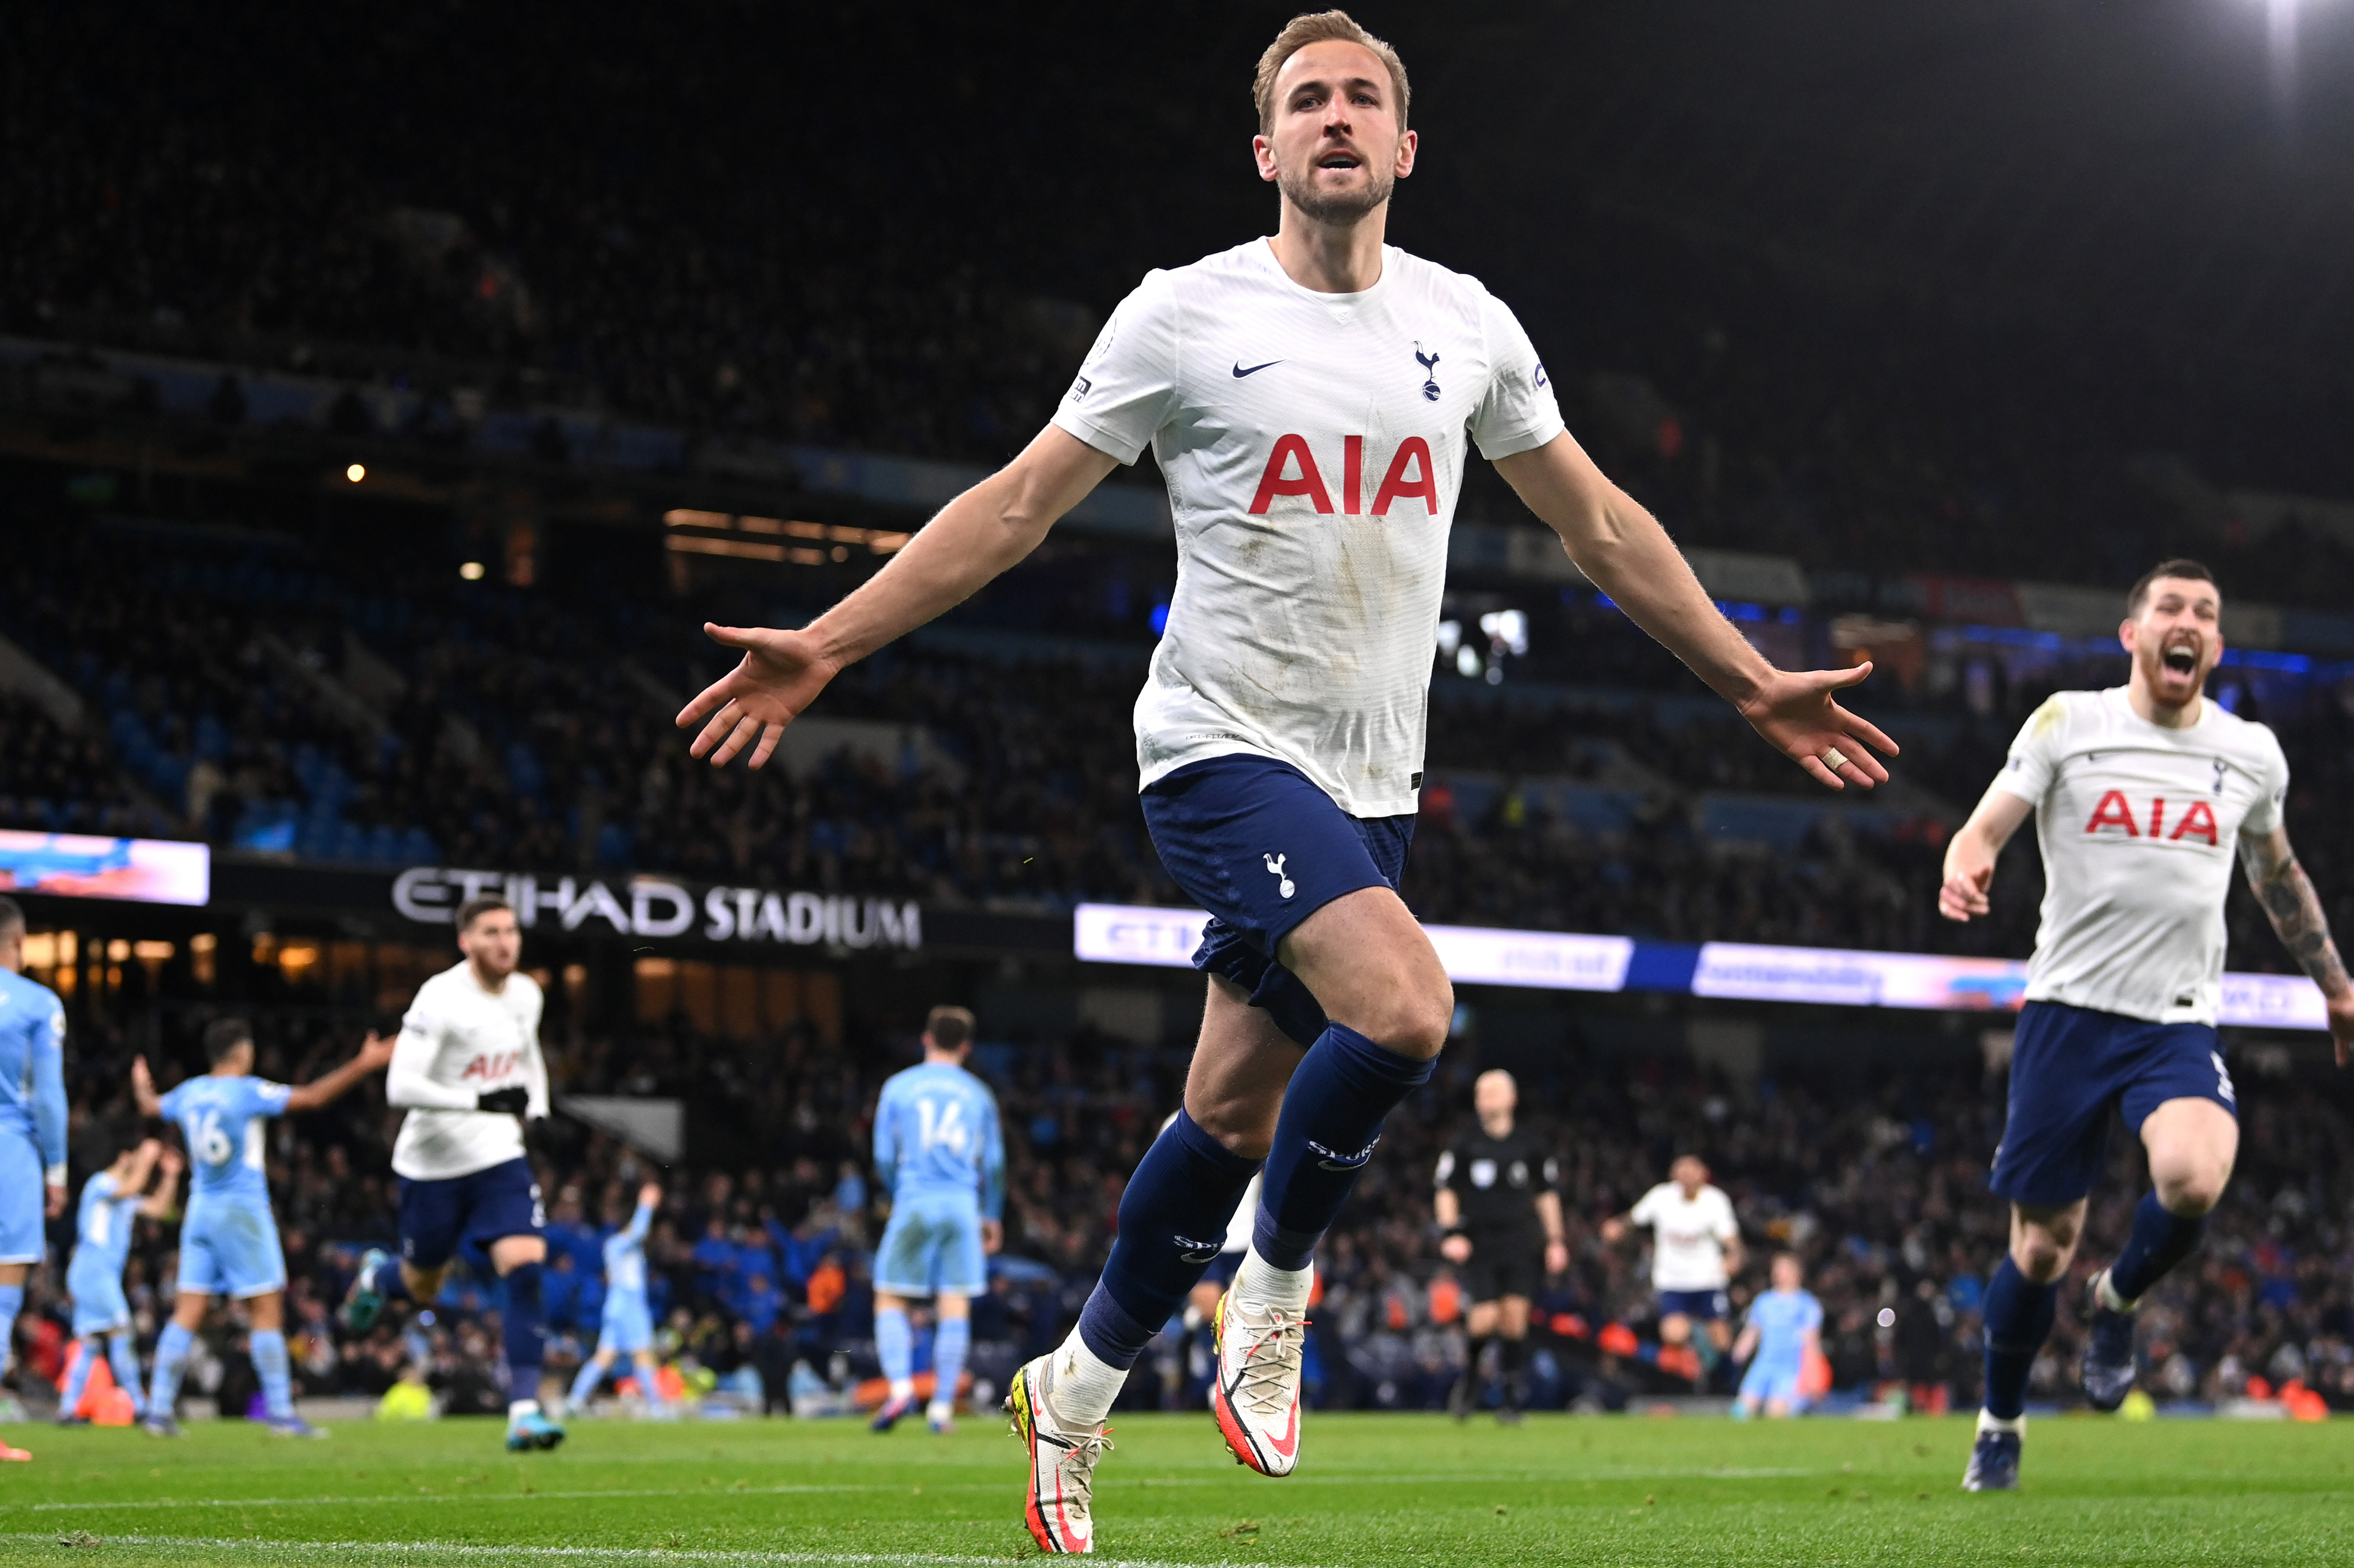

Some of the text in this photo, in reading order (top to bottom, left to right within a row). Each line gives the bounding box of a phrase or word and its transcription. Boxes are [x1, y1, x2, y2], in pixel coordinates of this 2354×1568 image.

[1248, 433, 1438, 516] AIA
[2085, 790, 2218, 847] AIA
[391, 866, 922, 950] ETIHAD STADIUM
[185, 1108, 232, 1167] 16
[917, 1097, 968, 1155] 14
